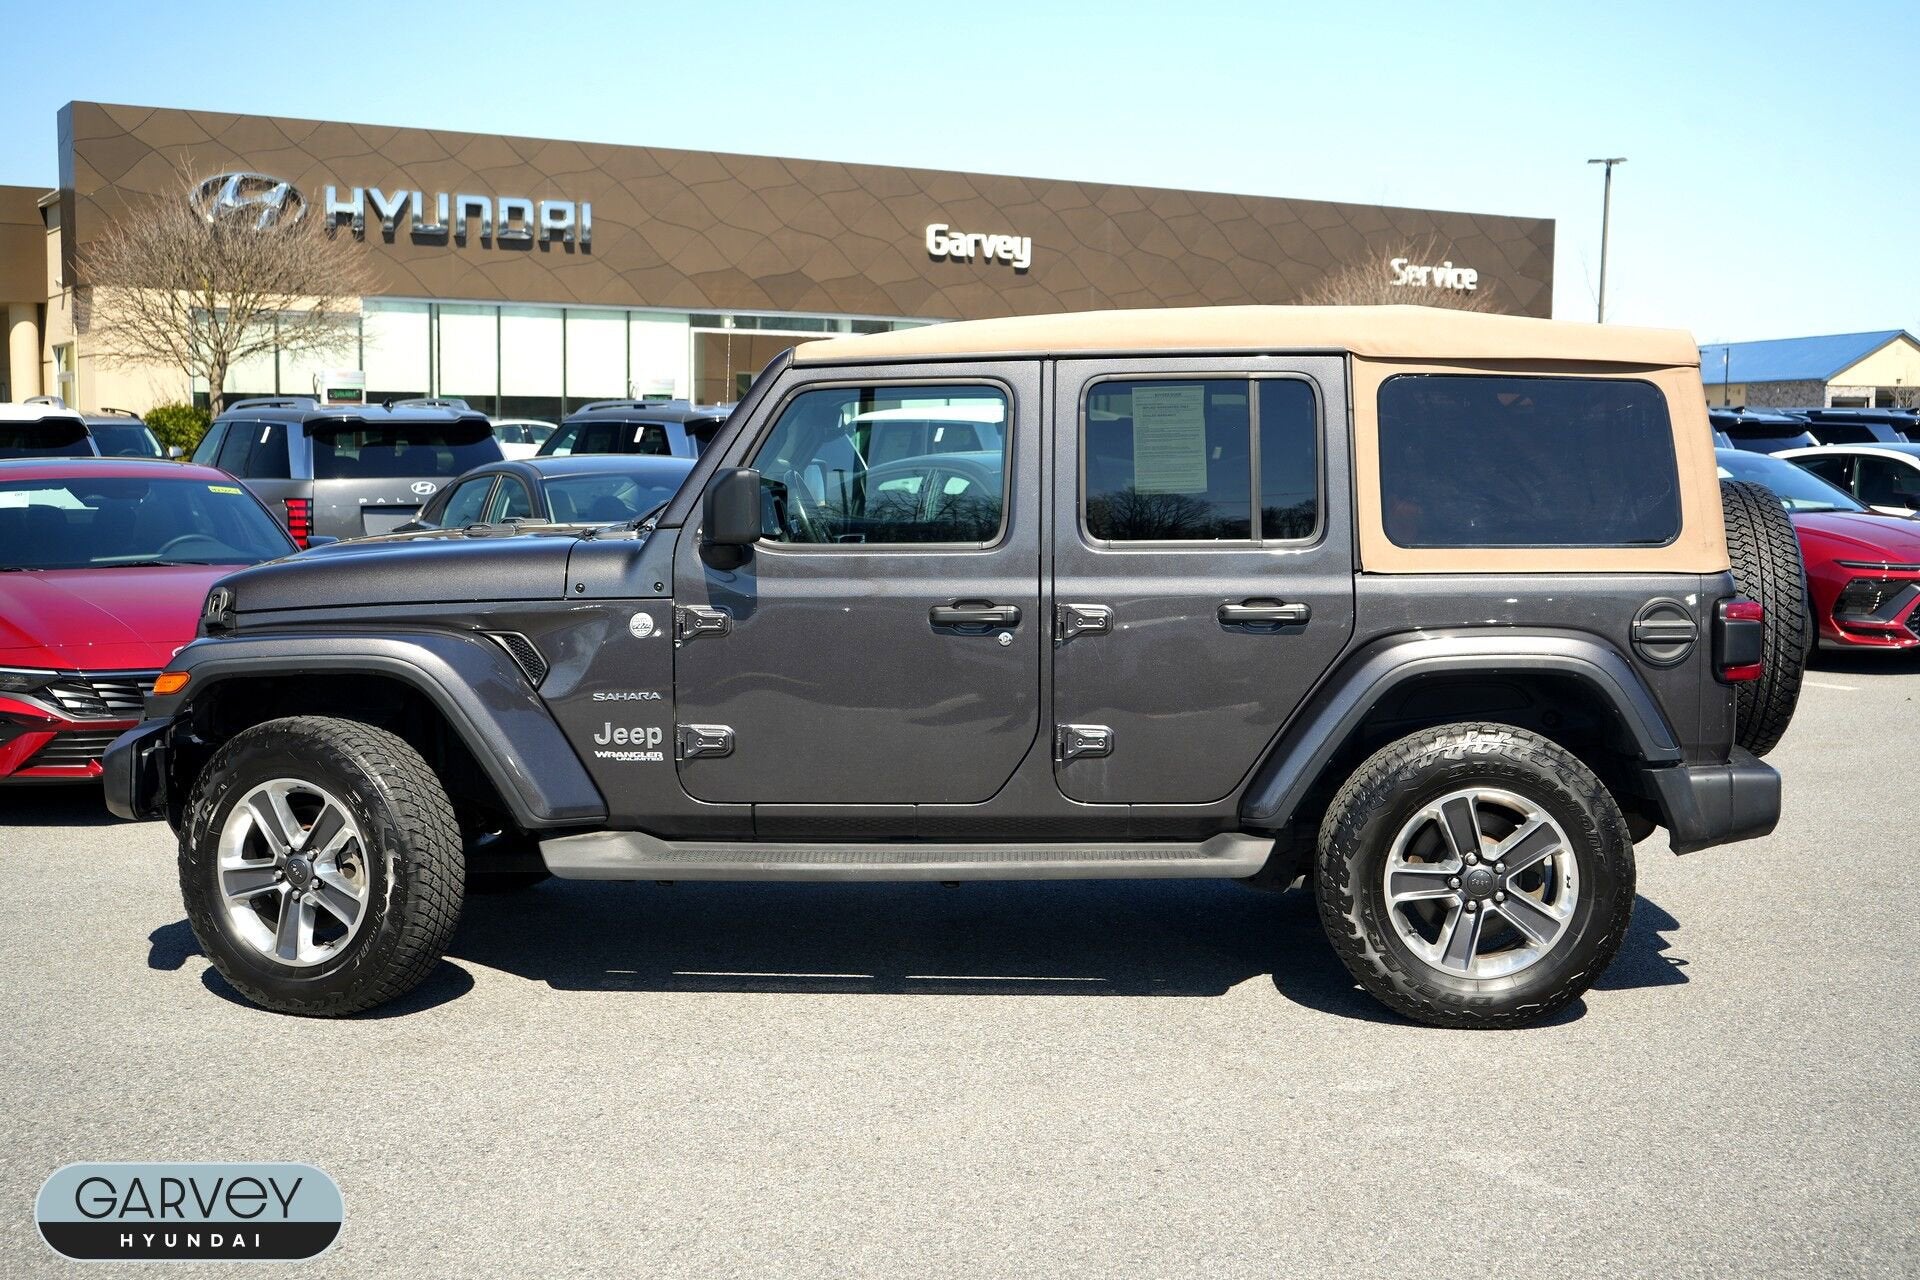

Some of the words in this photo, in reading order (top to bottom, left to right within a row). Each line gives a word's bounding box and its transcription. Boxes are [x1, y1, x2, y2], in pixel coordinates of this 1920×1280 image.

[323, 185, 592, 246] HYUNDAI
[926, 223, 1032, 269] Garvey
[1389, 257, 1479, 290] Service
[592, 691, 662, 702] SAHARA
[593, 722, 663, 749] Jeep
[594, 750, 664, 758] WRANGLER
